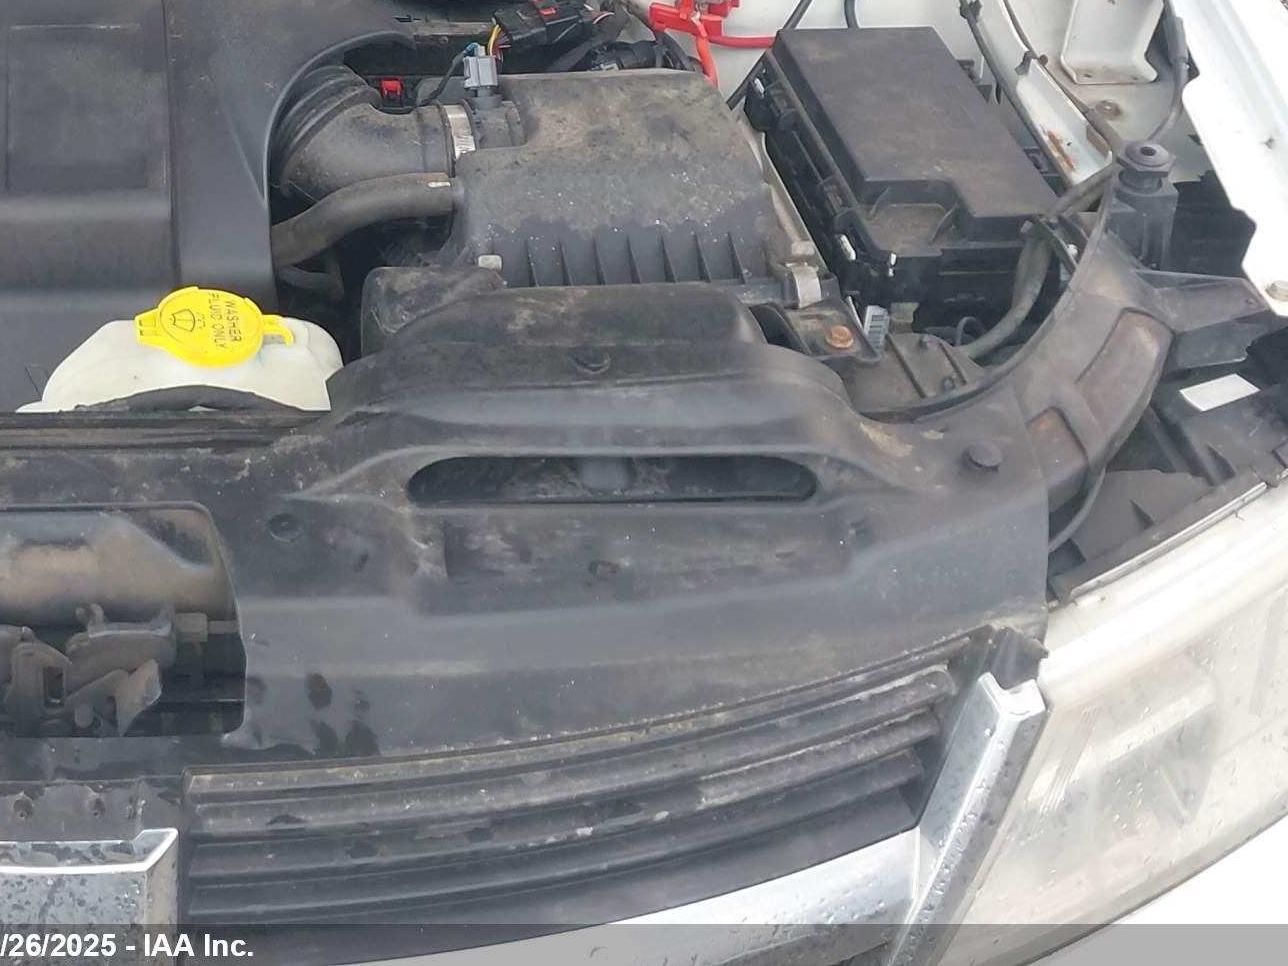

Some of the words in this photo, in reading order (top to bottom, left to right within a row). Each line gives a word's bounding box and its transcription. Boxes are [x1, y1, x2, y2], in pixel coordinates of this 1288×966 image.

[208, 292, 223, 321] FLUID
[225, 300, 242, 342] WASHER
[212, 323, 227, 348] ONLY
